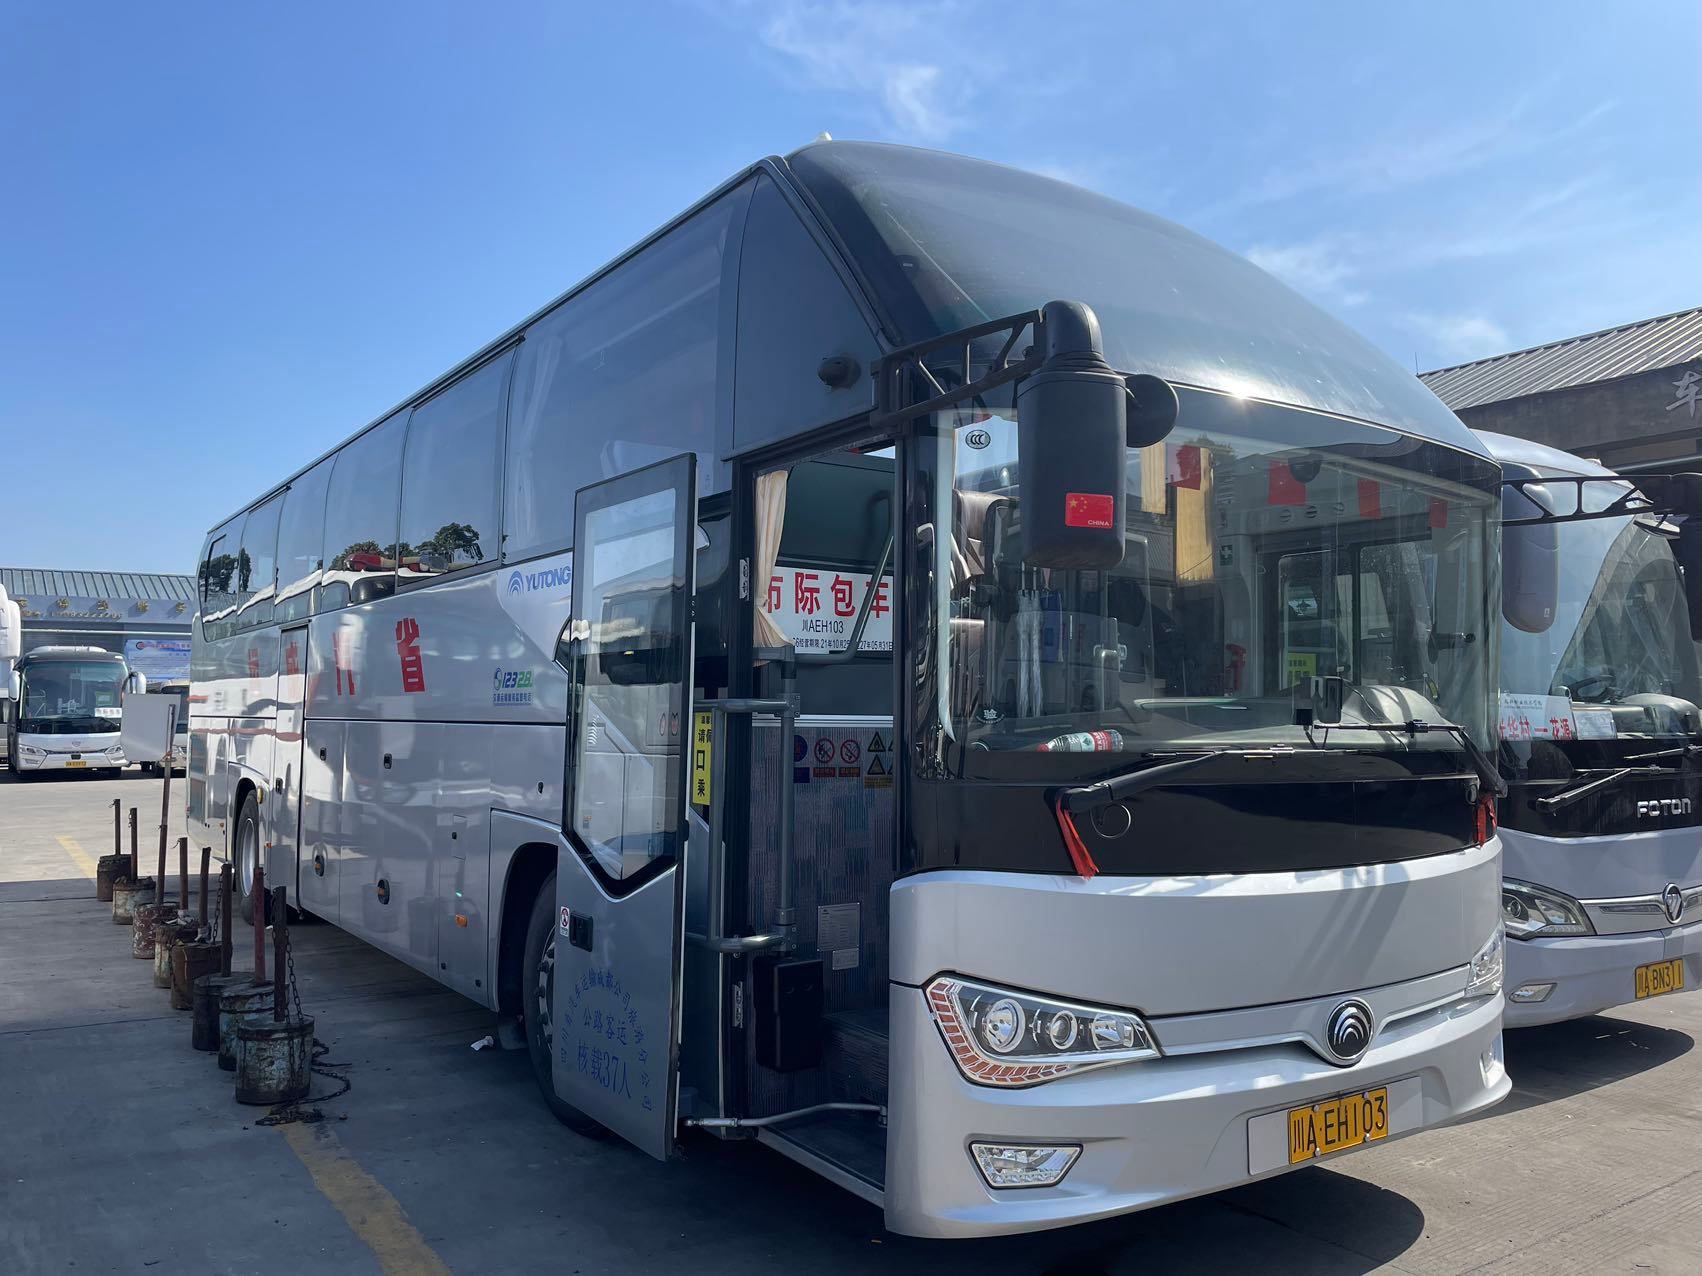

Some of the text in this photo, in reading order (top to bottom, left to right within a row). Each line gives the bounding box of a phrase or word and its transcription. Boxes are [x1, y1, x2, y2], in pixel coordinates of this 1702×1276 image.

[1087, 519, 1110, 527] CHINA
[526, 565, 571, 592] YUTONG
[802, 619, 844, 635] 川AEH103
[502, 670, 532, 689] 12328
[1637, 798, 1692, 818] FOTON
[582, 1006, 628, 1046] 公路客运
[576, 1038, 632, 1099] 核载37人
